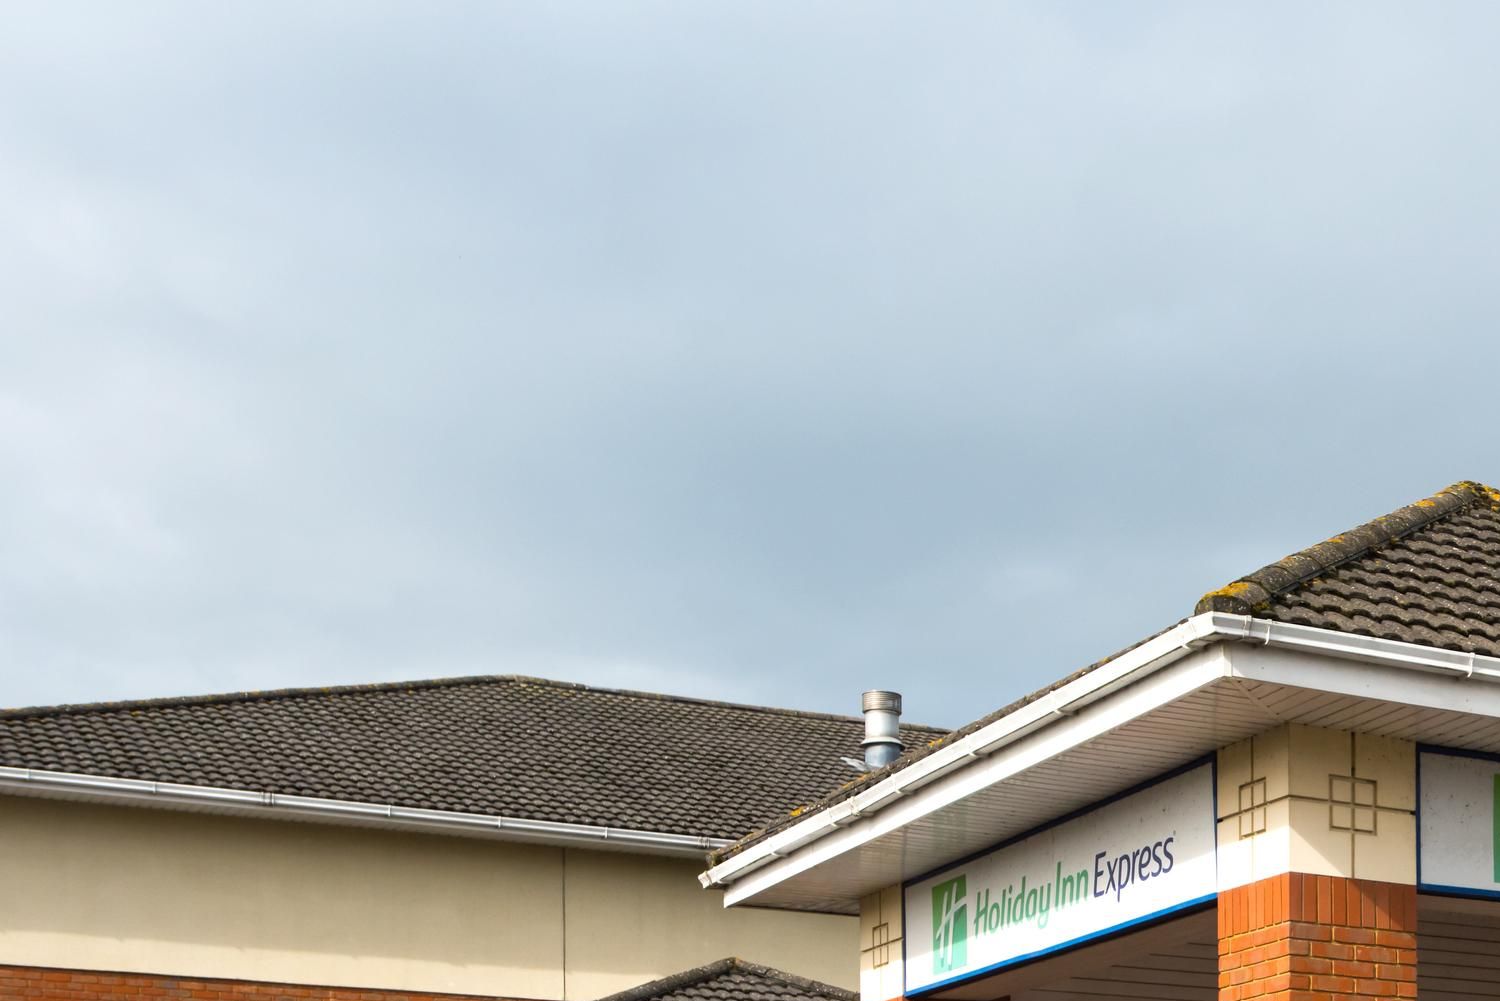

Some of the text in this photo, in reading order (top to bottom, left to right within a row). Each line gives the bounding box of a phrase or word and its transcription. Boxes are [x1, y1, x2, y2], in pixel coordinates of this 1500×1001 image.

[974, 875, 1052, 939] Holiday
[1055, 861, 1089, 911] Inn
[1093, 836, 1174, 903] Express
